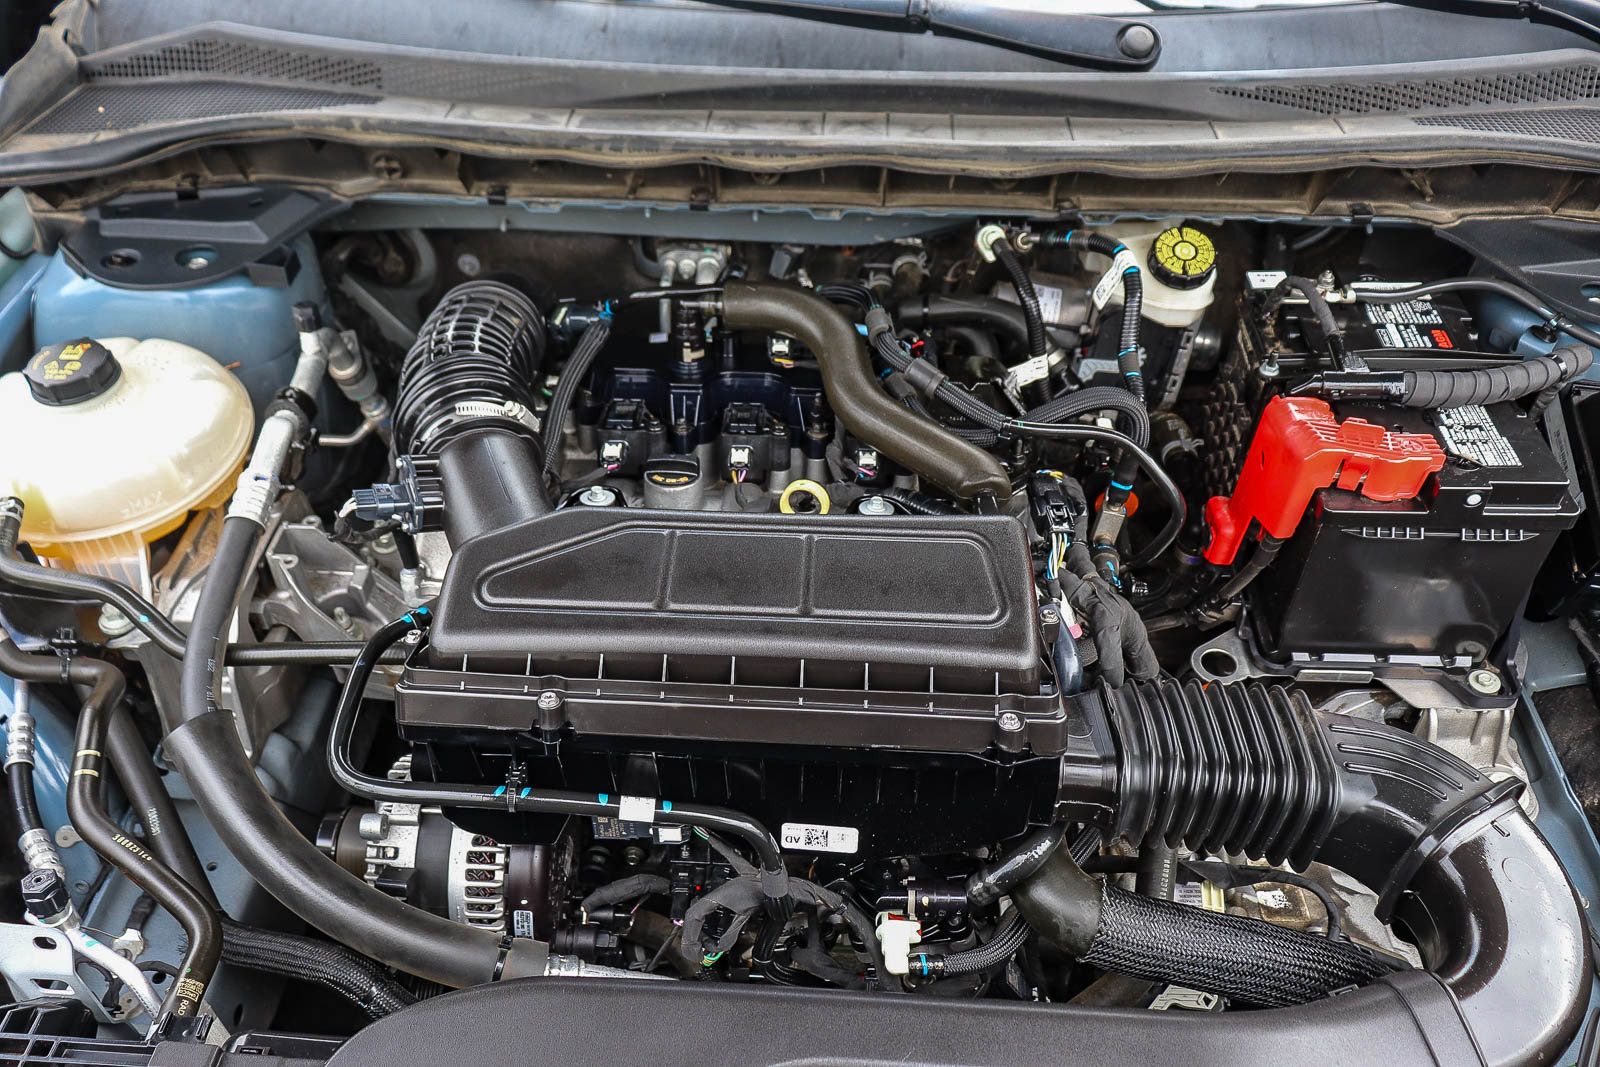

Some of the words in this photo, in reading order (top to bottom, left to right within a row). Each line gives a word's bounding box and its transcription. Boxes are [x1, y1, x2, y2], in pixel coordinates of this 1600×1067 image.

[126, 489, 169, 515] MAX
[785, 835, 801, 844] AD
[178, 999, 189, 1016] RAD
